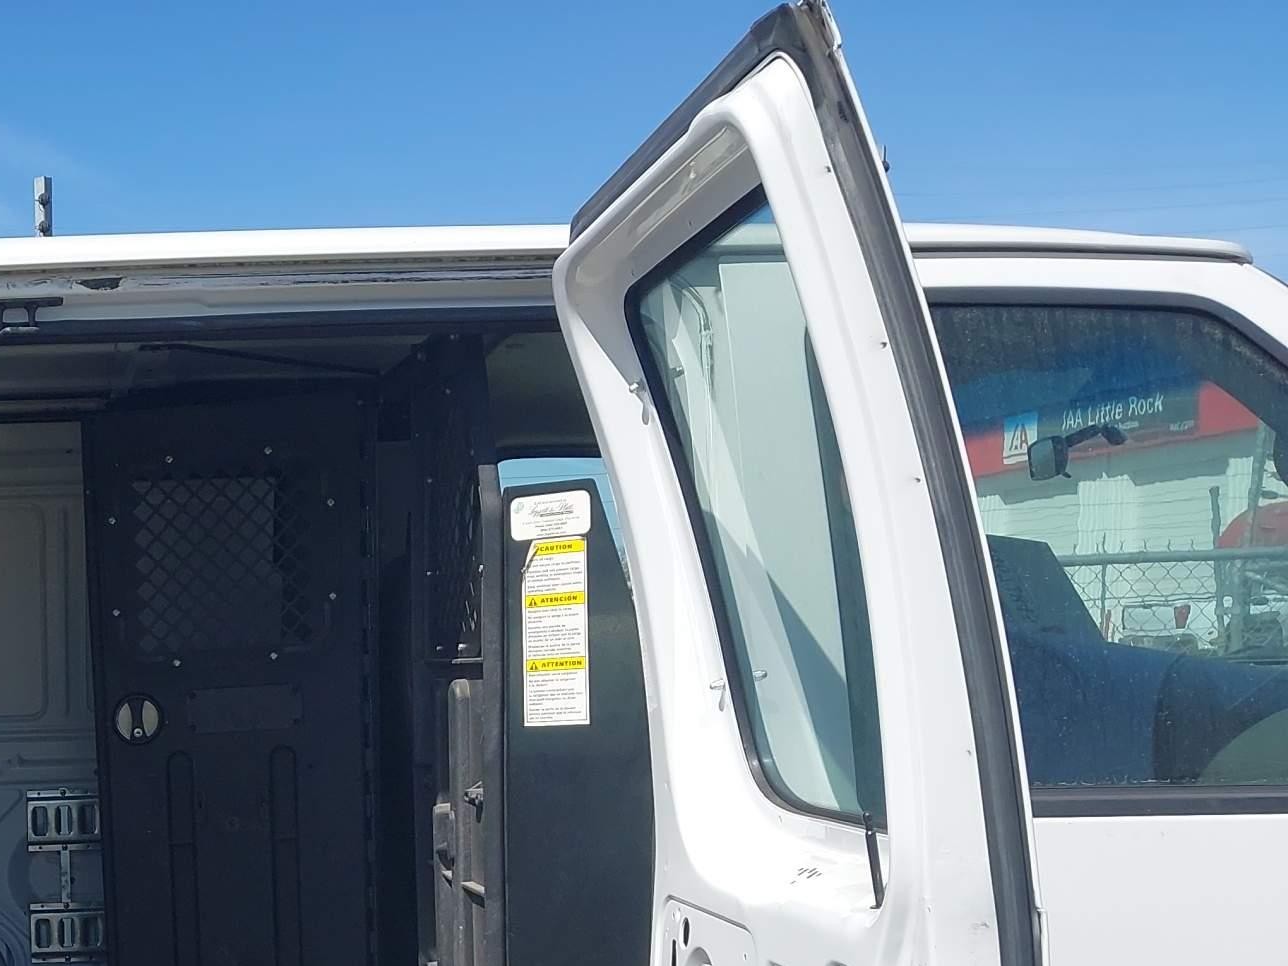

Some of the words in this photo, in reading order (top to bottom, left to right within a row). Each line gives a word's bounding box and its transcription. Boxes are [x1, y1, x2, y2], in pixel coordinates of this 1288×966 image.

[1062, 409, 1084, 431] IAA
[1088, 401, 1123, 425] Little
[1127, 392, 1164, 418] Rock
[539, 543, 573, 553] CAUTION
[541, 660, 582, 669] ATTENTION
